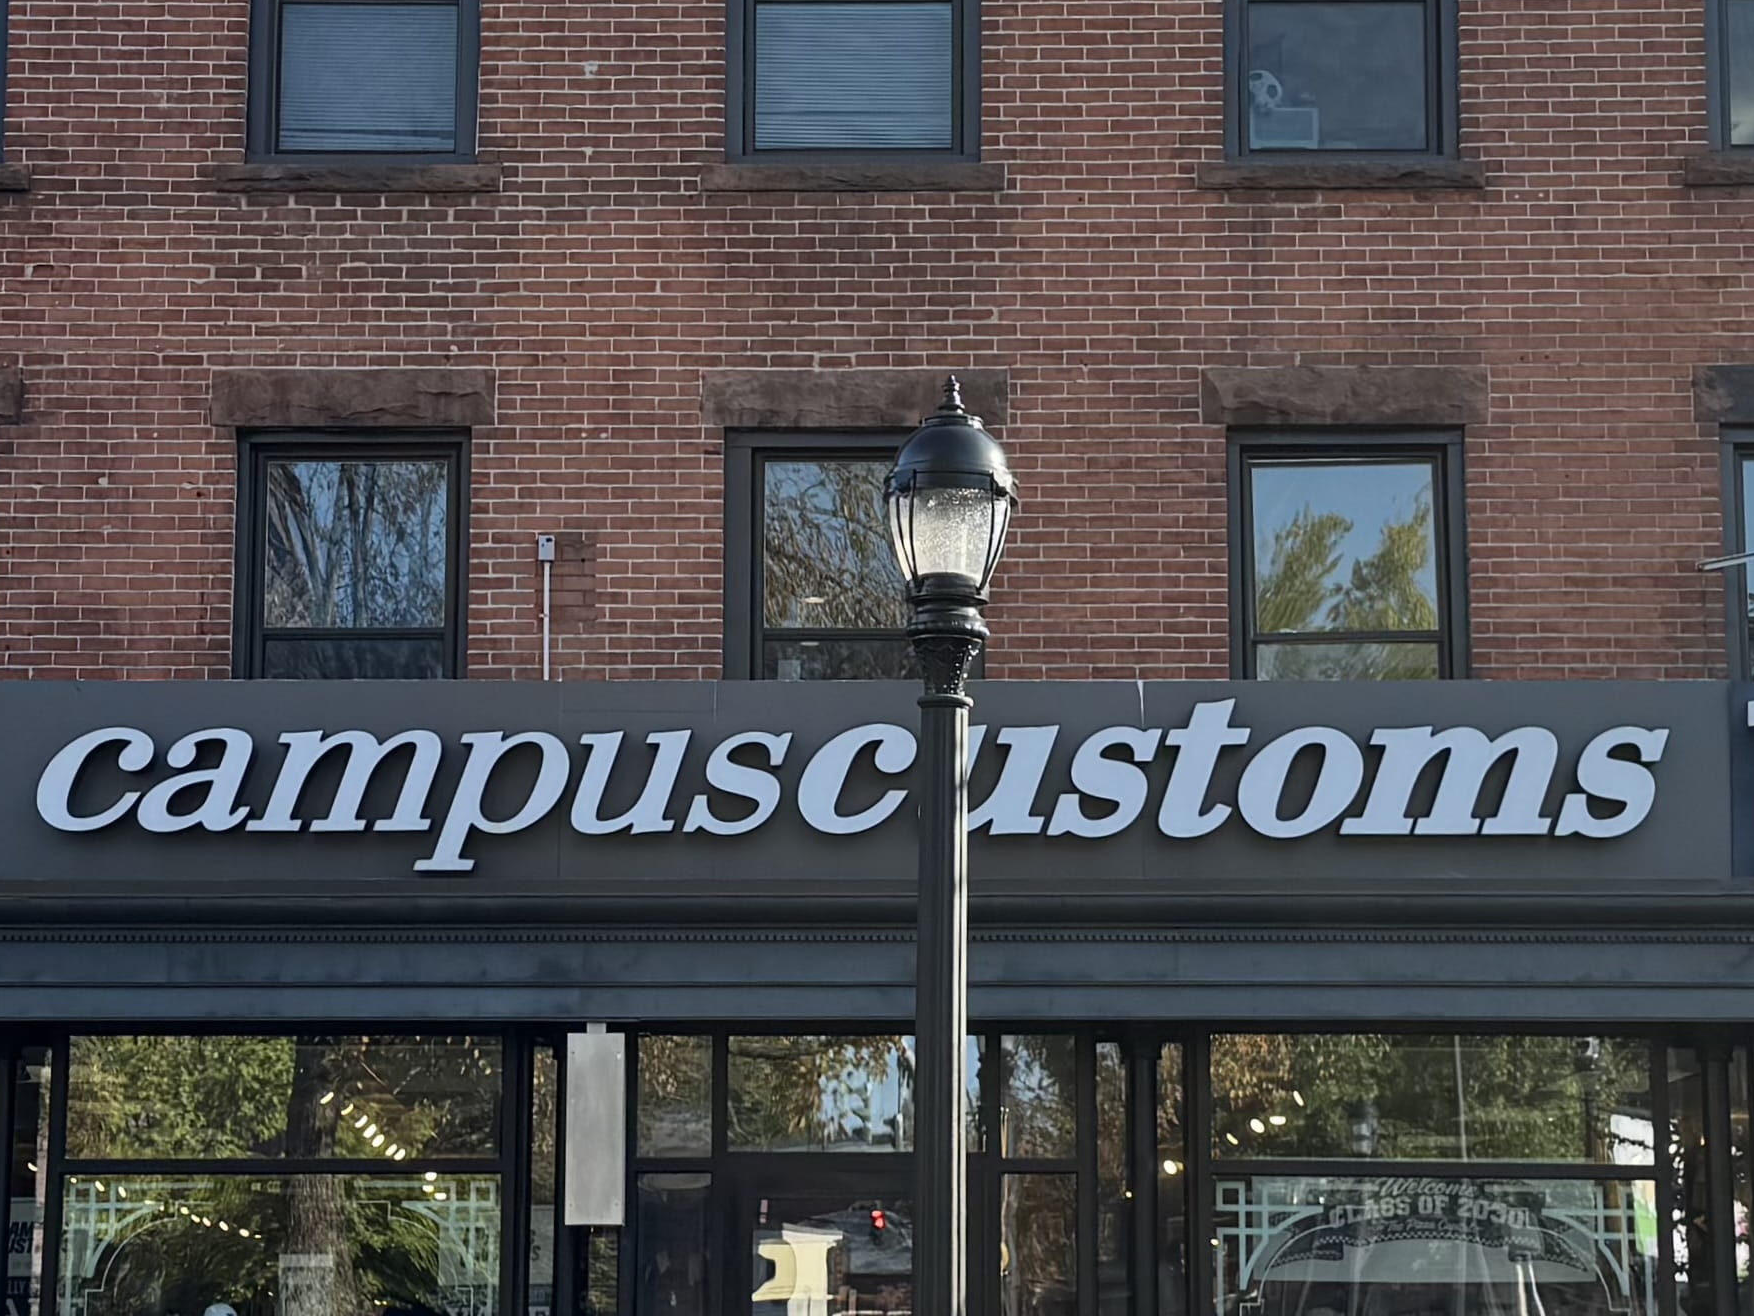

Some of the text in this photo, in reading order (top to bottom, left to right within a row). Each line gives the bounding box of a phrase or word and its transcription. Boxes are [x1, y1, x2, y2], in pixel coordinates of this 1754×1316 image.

[35, 697, 1670, 872] campuscustoms
[1378, 1177, 1479, 1198] Welcome
[1417, 1194, 1450, 1216] OF
